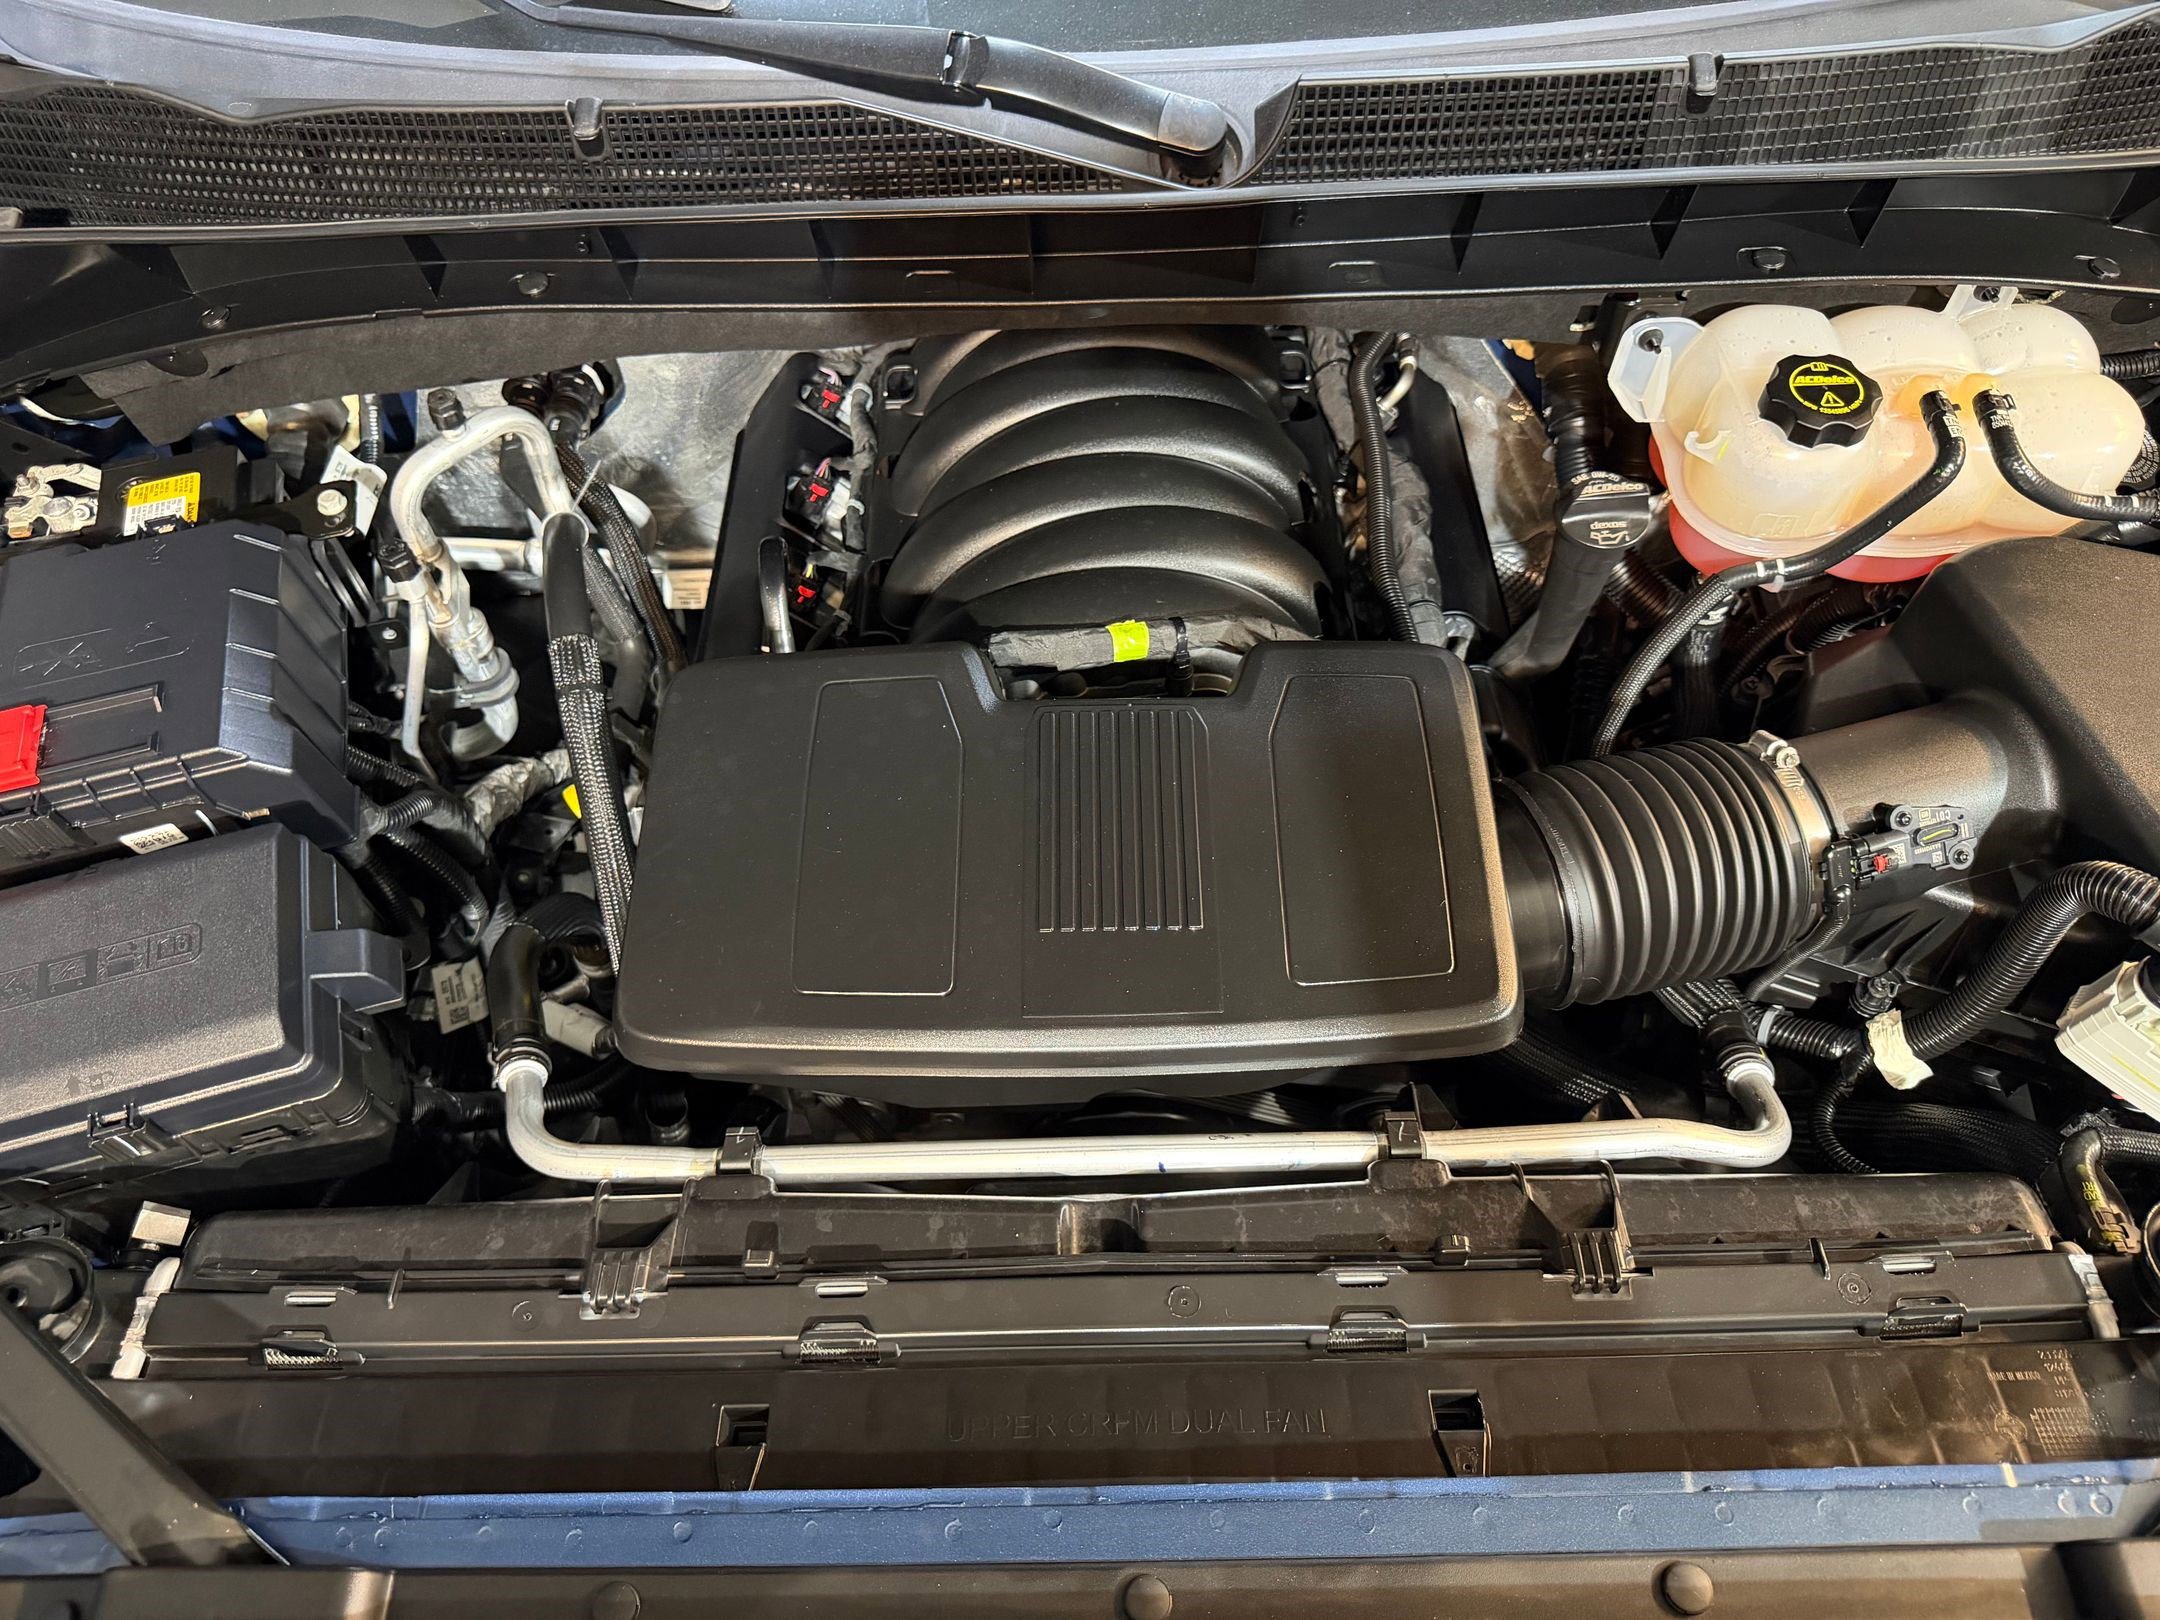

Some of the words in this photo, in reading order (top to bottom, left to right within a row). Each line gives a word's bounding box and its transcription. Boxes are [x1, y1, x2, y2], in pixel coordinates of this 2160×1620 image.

[1794, 374, 1855, 384] ACDelco
[1571, 472, 1589, 485] SAE
[1591, 470, 1620, 482] 0W-20
[1580, 481, 1644, 495] ACDelco
[1988, 1371, 2006, 1381] MADE
[2014, 1371, 2041, 1380] MEXICO
[946, 1413, 1057, 1442] UPPER
[1067, 1408, 1159, 1437] CRFM
[1170, 1407, 1255, 1435] DUAL
[1264, 1407, 1328, 1434] FAN
